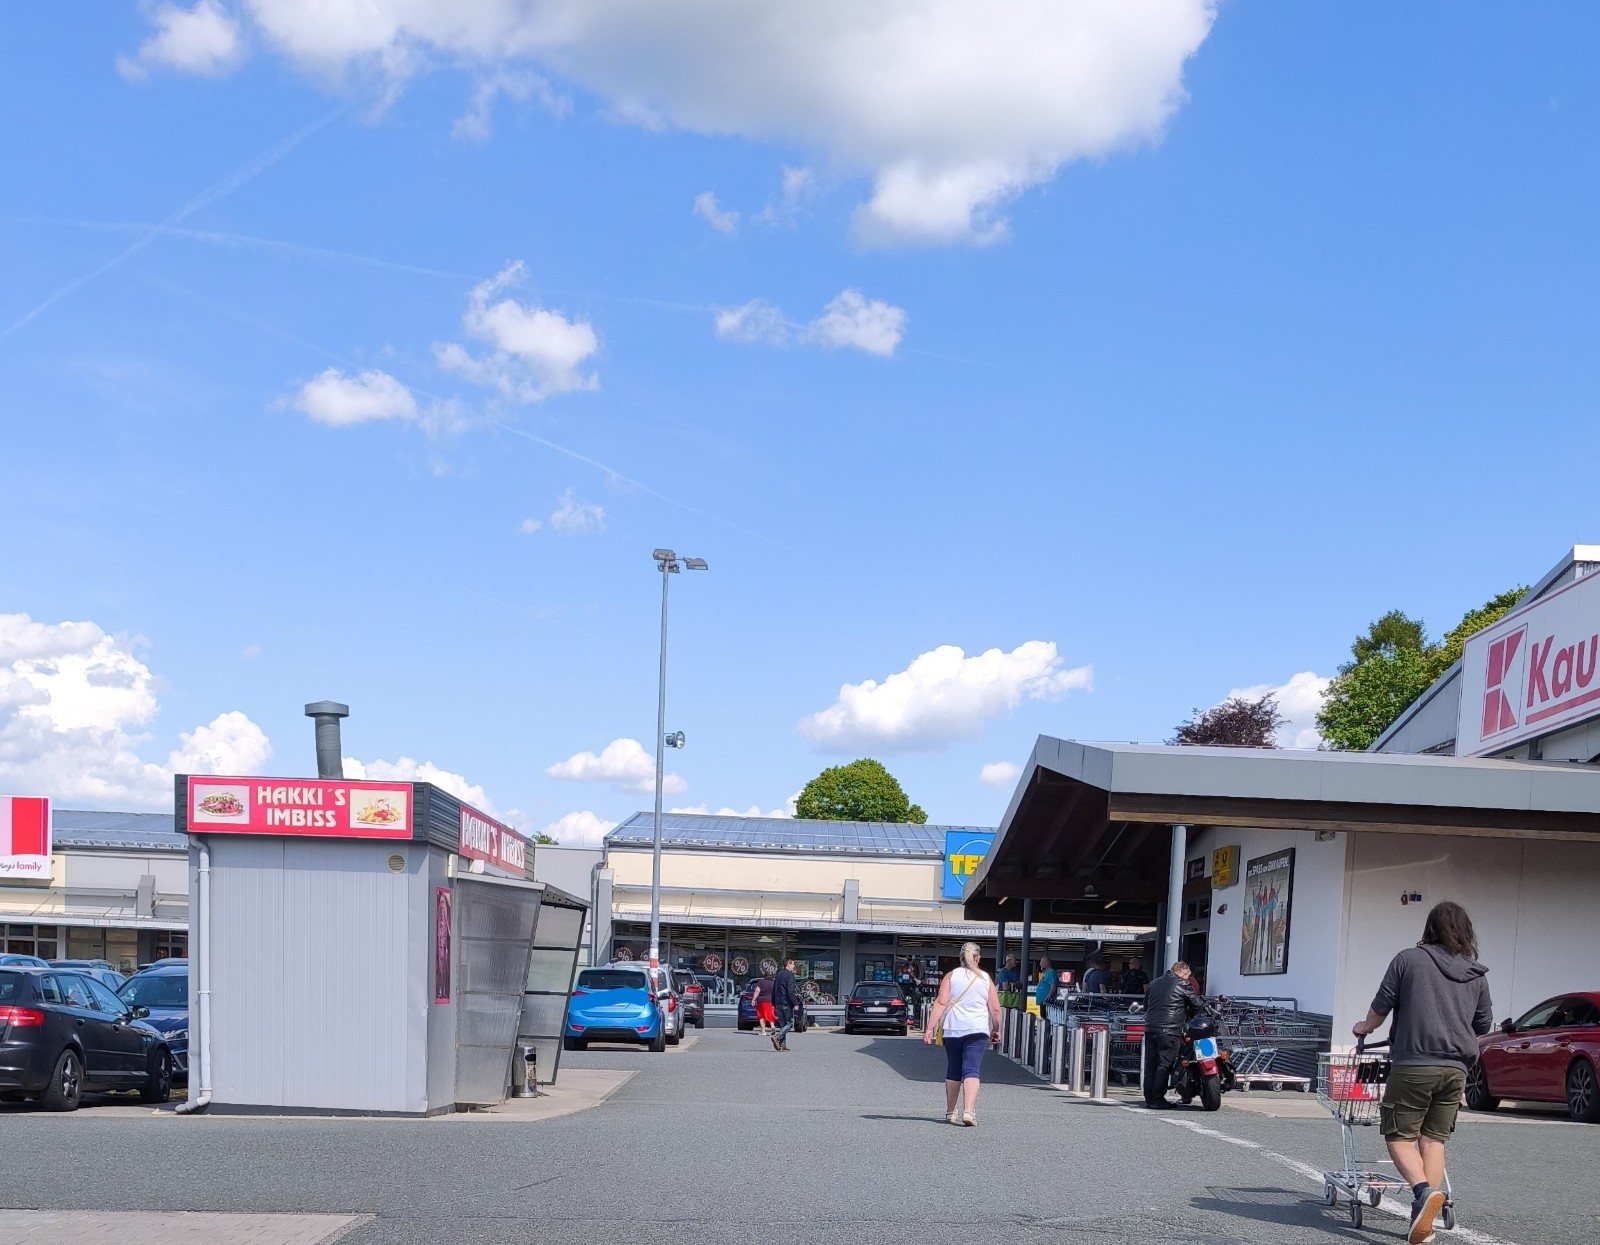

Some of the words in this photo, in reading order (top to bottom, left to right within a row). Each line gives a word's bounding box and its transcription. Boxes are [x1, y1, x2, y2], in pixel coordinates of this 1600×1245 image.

[1527, 634, 1600, 708] Kau
[266, 807, 337, 828] IMBISS
[16, 861, 42, 872] family
